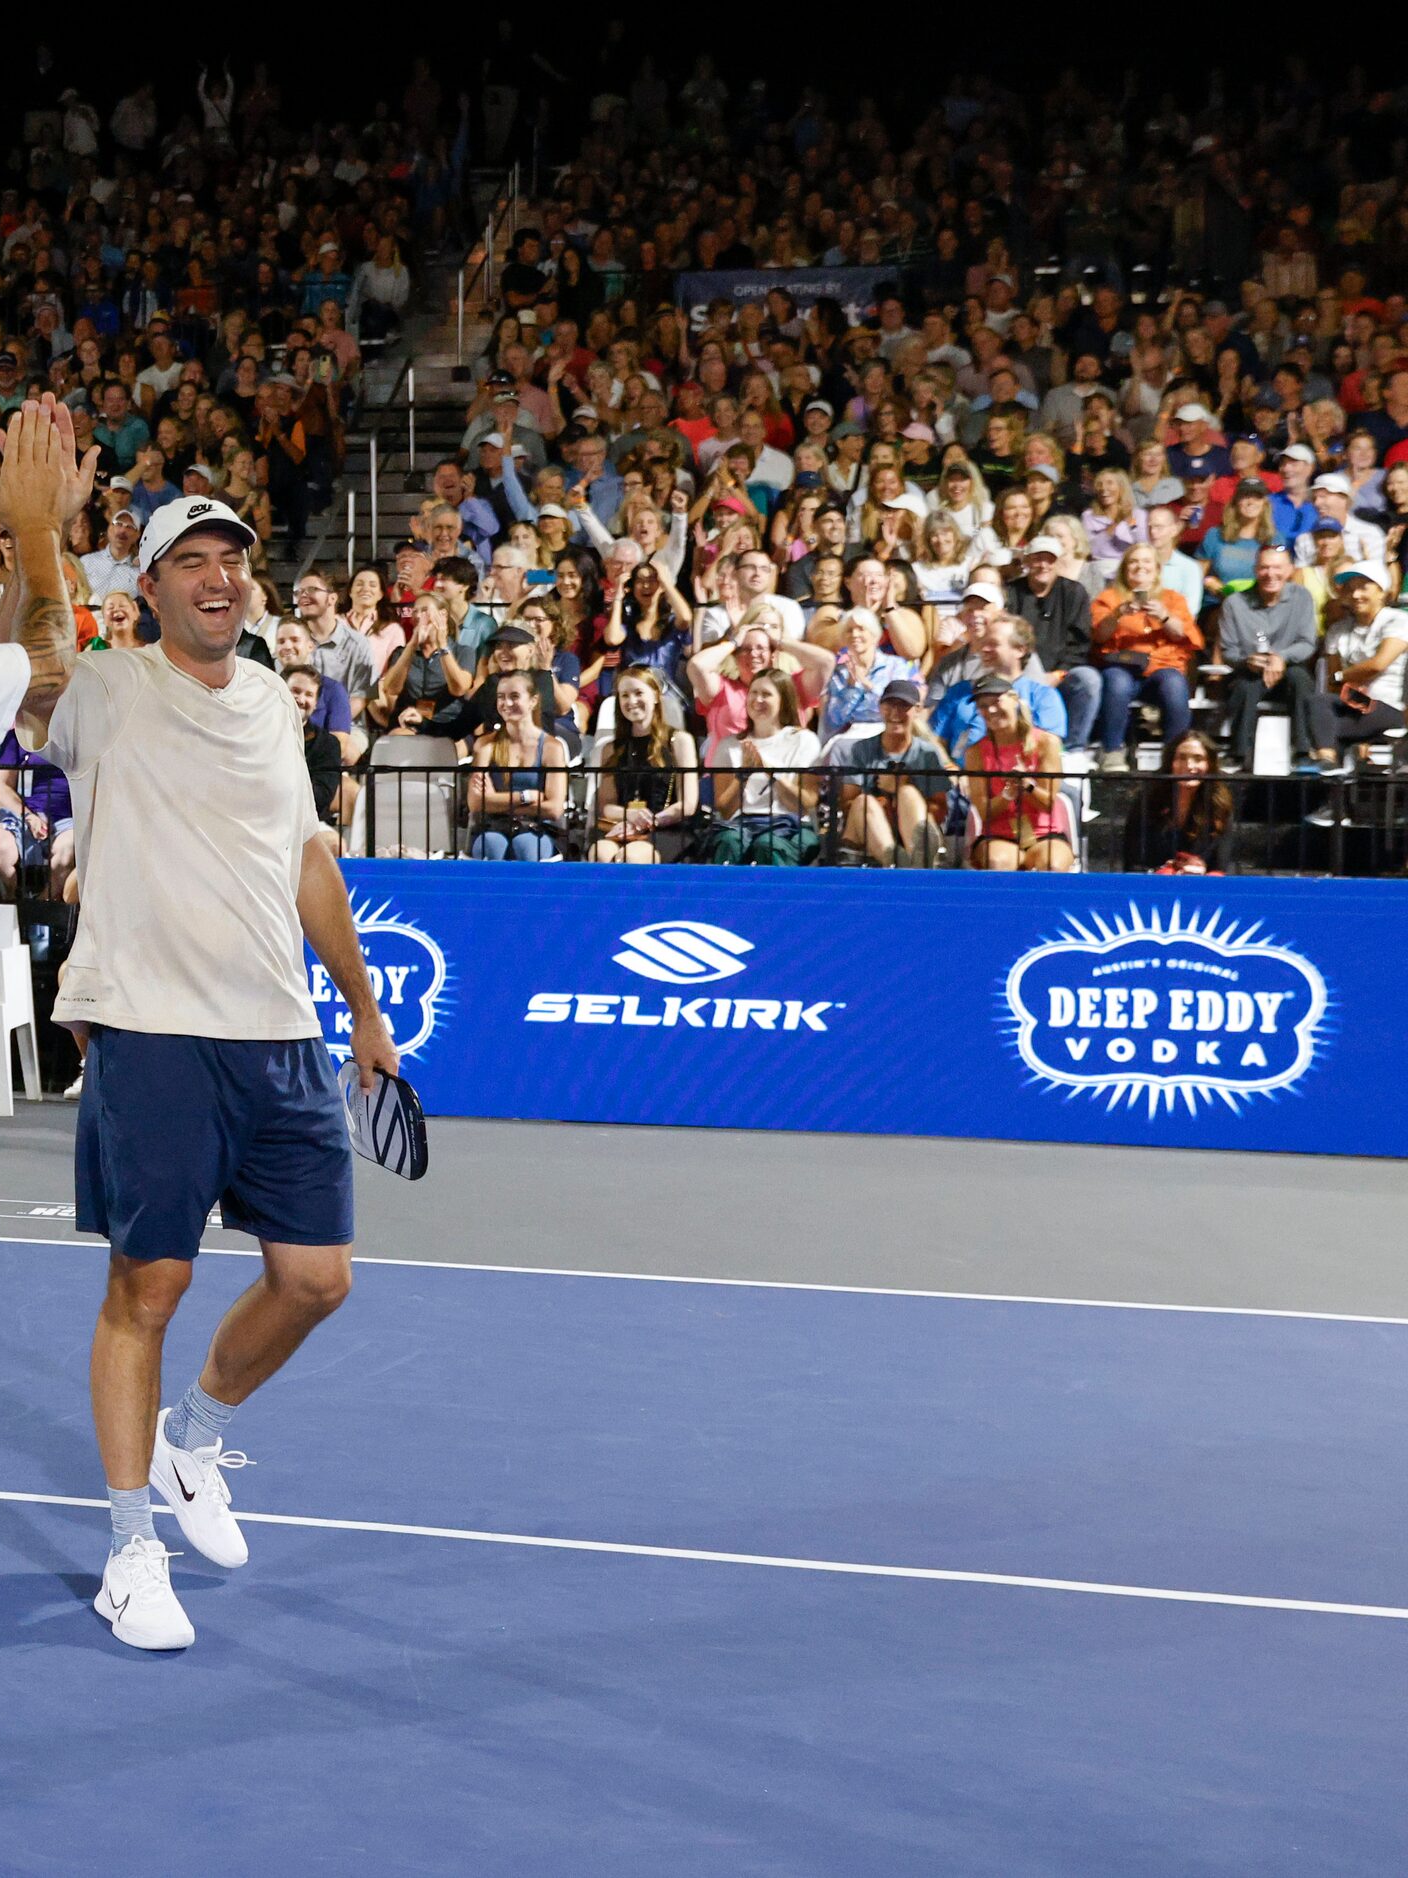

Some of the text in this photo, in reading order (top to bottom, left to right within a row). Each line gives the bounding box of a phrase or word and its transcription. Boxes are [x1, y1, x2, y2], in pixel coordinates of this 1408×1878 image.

[190, 503, 213, 513] GOLF
[1092, 957, 1240, 982] AUSTIN'S ORIGINAL
[524, 992, 833, 1031] SELKIRK
[1048, 986, 1284, 1034] DEEP EDDY
[1064, 1037, 1268, 1067] VODKA
